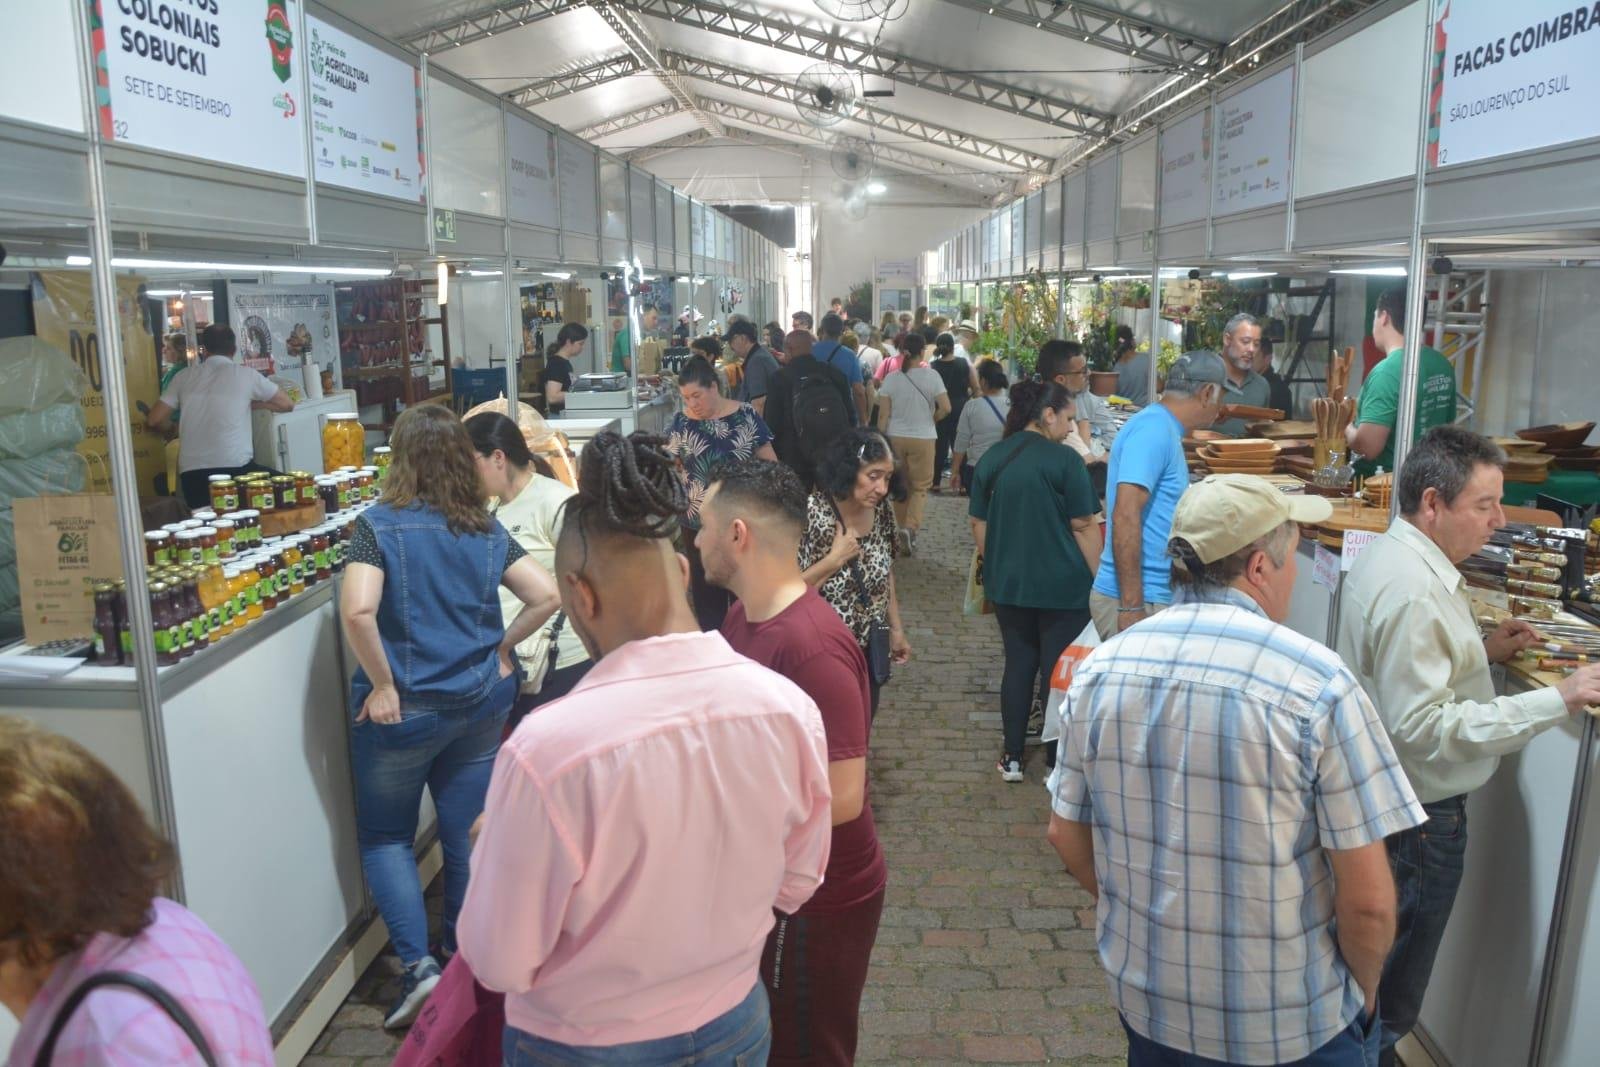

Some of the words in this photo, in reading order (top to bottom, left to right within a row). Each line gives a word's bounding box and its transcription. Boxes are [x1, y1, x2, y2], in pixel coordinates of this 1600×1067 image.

[117, 0, 220, 48] COLONIAIS
[1453, 38, 1505, 77] FACAS
[1510, 1, 1600, 57] COIMBRA
[120, 25, 207, 76] SOBUCKI
[325, 56, 369, 84] AGRICULTURA
[125, 75, 154, 98] SETE
[158, 85, 173, 104] DE
[176, 90, 232, 118] SETEMBRO
[325, 71, 358, 93] FAMILIAR
[1450, 103, 1468, 122] SÃO
[1470, 87, 1525, 118] LOURENÇO
[1527, 82, 1545, 101] DO
[1548, 75, 1570, 95] SUL
[114, 120, 129, 139] 32
